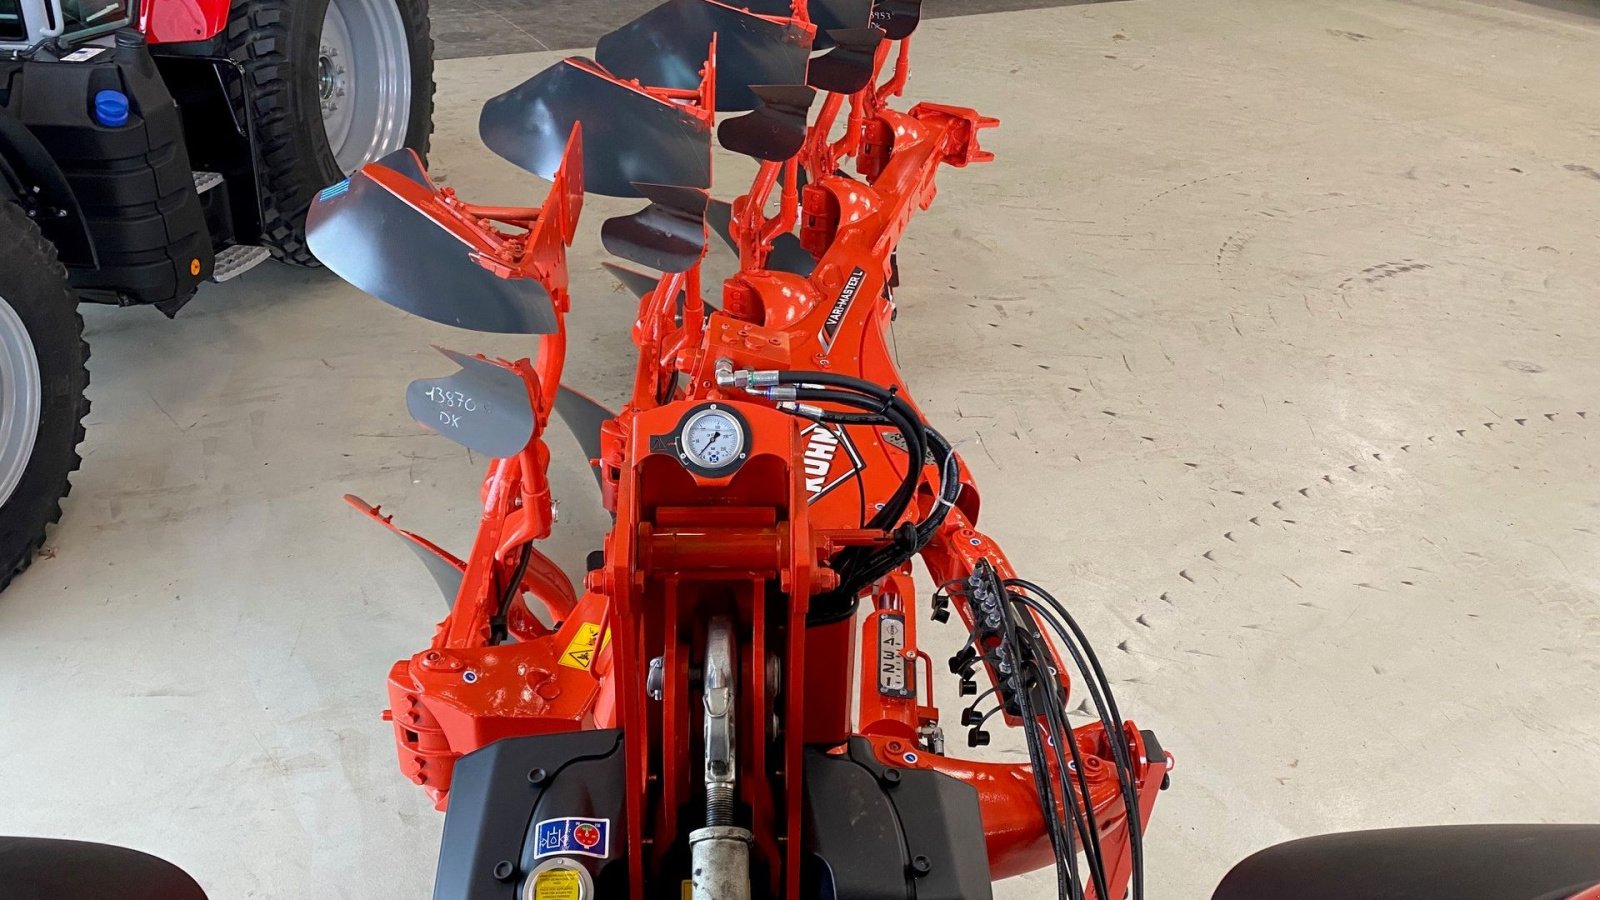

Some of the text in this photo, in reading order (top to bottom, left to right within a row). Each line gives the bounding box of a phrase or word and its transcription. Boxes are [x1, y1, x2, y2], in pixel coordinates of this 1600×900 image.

[825, 275, 861, 325] VARI-MASTER
[425, 387, 476, 412] 13870
[439, 411, 462, 428] DK
[803, 427, 842, 493] KUHN
